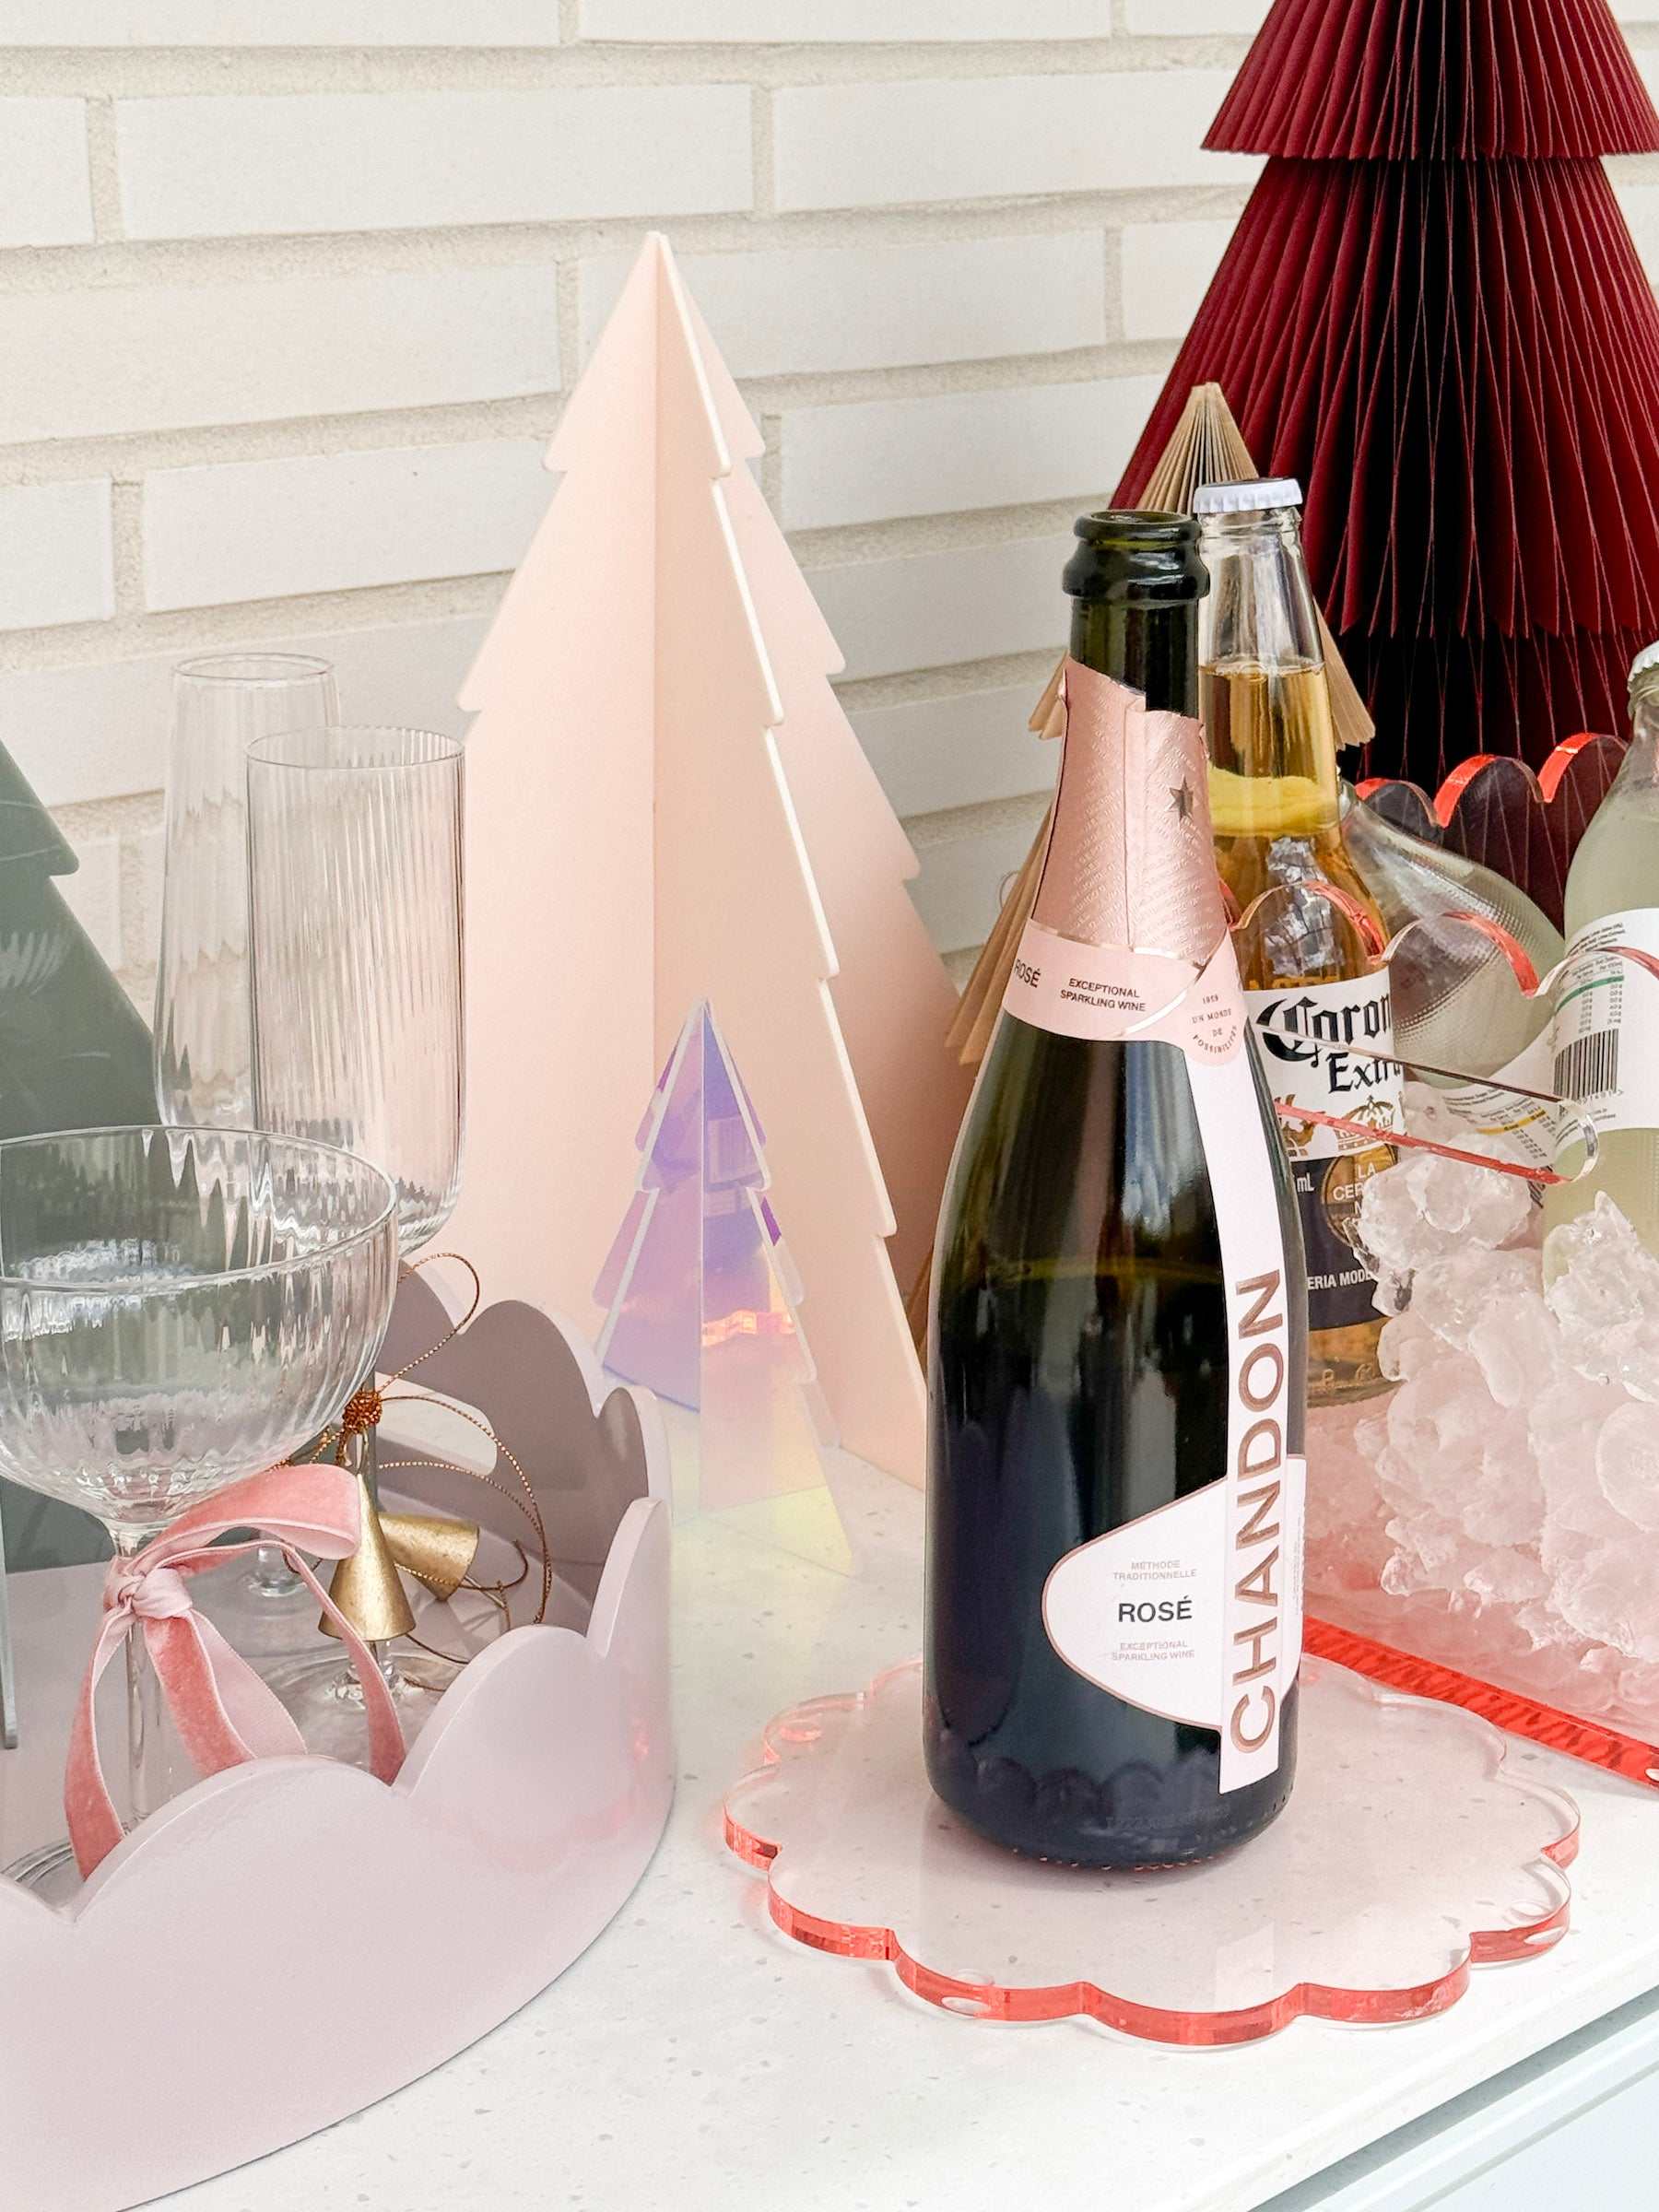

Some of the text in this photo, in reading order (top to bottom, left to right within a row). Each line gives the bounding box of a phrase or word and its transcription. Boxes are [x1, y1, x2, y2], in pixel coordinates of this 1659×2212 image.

[1014, 959, 1041, 988] ROSÉ
[1060, 989, 1146, 1012] SPARKLING WINE
[1068, 977, 1140, 998] EXCEPTIONAL
[1230, 1269, 1284, 1754] CHANDON
[1118, 1594, 1193, 1623] ROSÉ
[1120, 1640, 1188, 1652] EXCEPTIONAL
